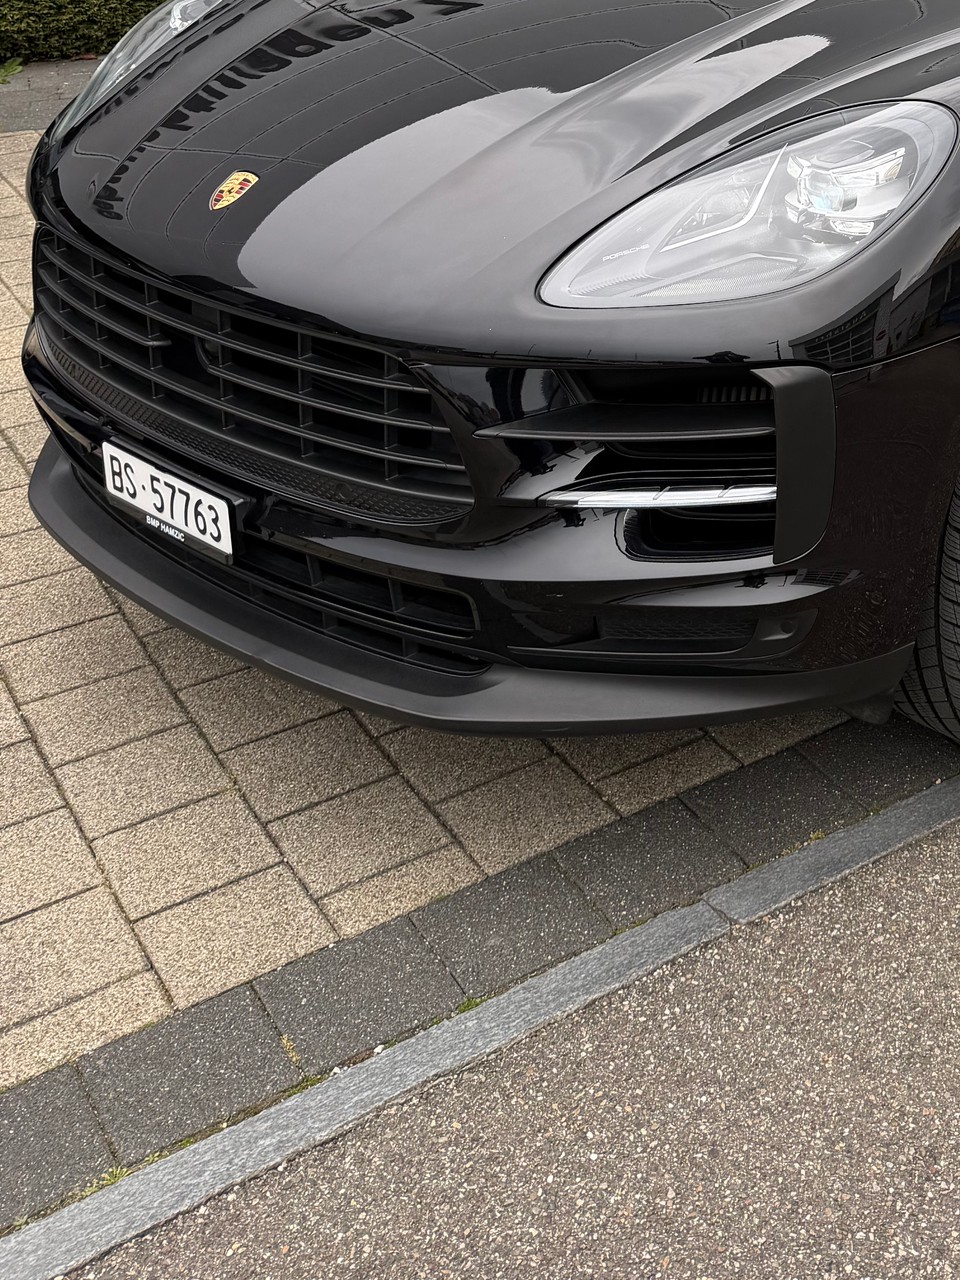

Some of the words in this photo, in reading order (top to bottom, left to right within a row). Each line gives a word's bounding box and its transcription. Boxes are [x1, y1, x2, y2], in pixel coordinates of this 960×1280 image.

[602, 243, 650, 261] PORSCHE
[146, 515, 160, 528] BMP
[160, 523, 185, 542] HAMZIC
